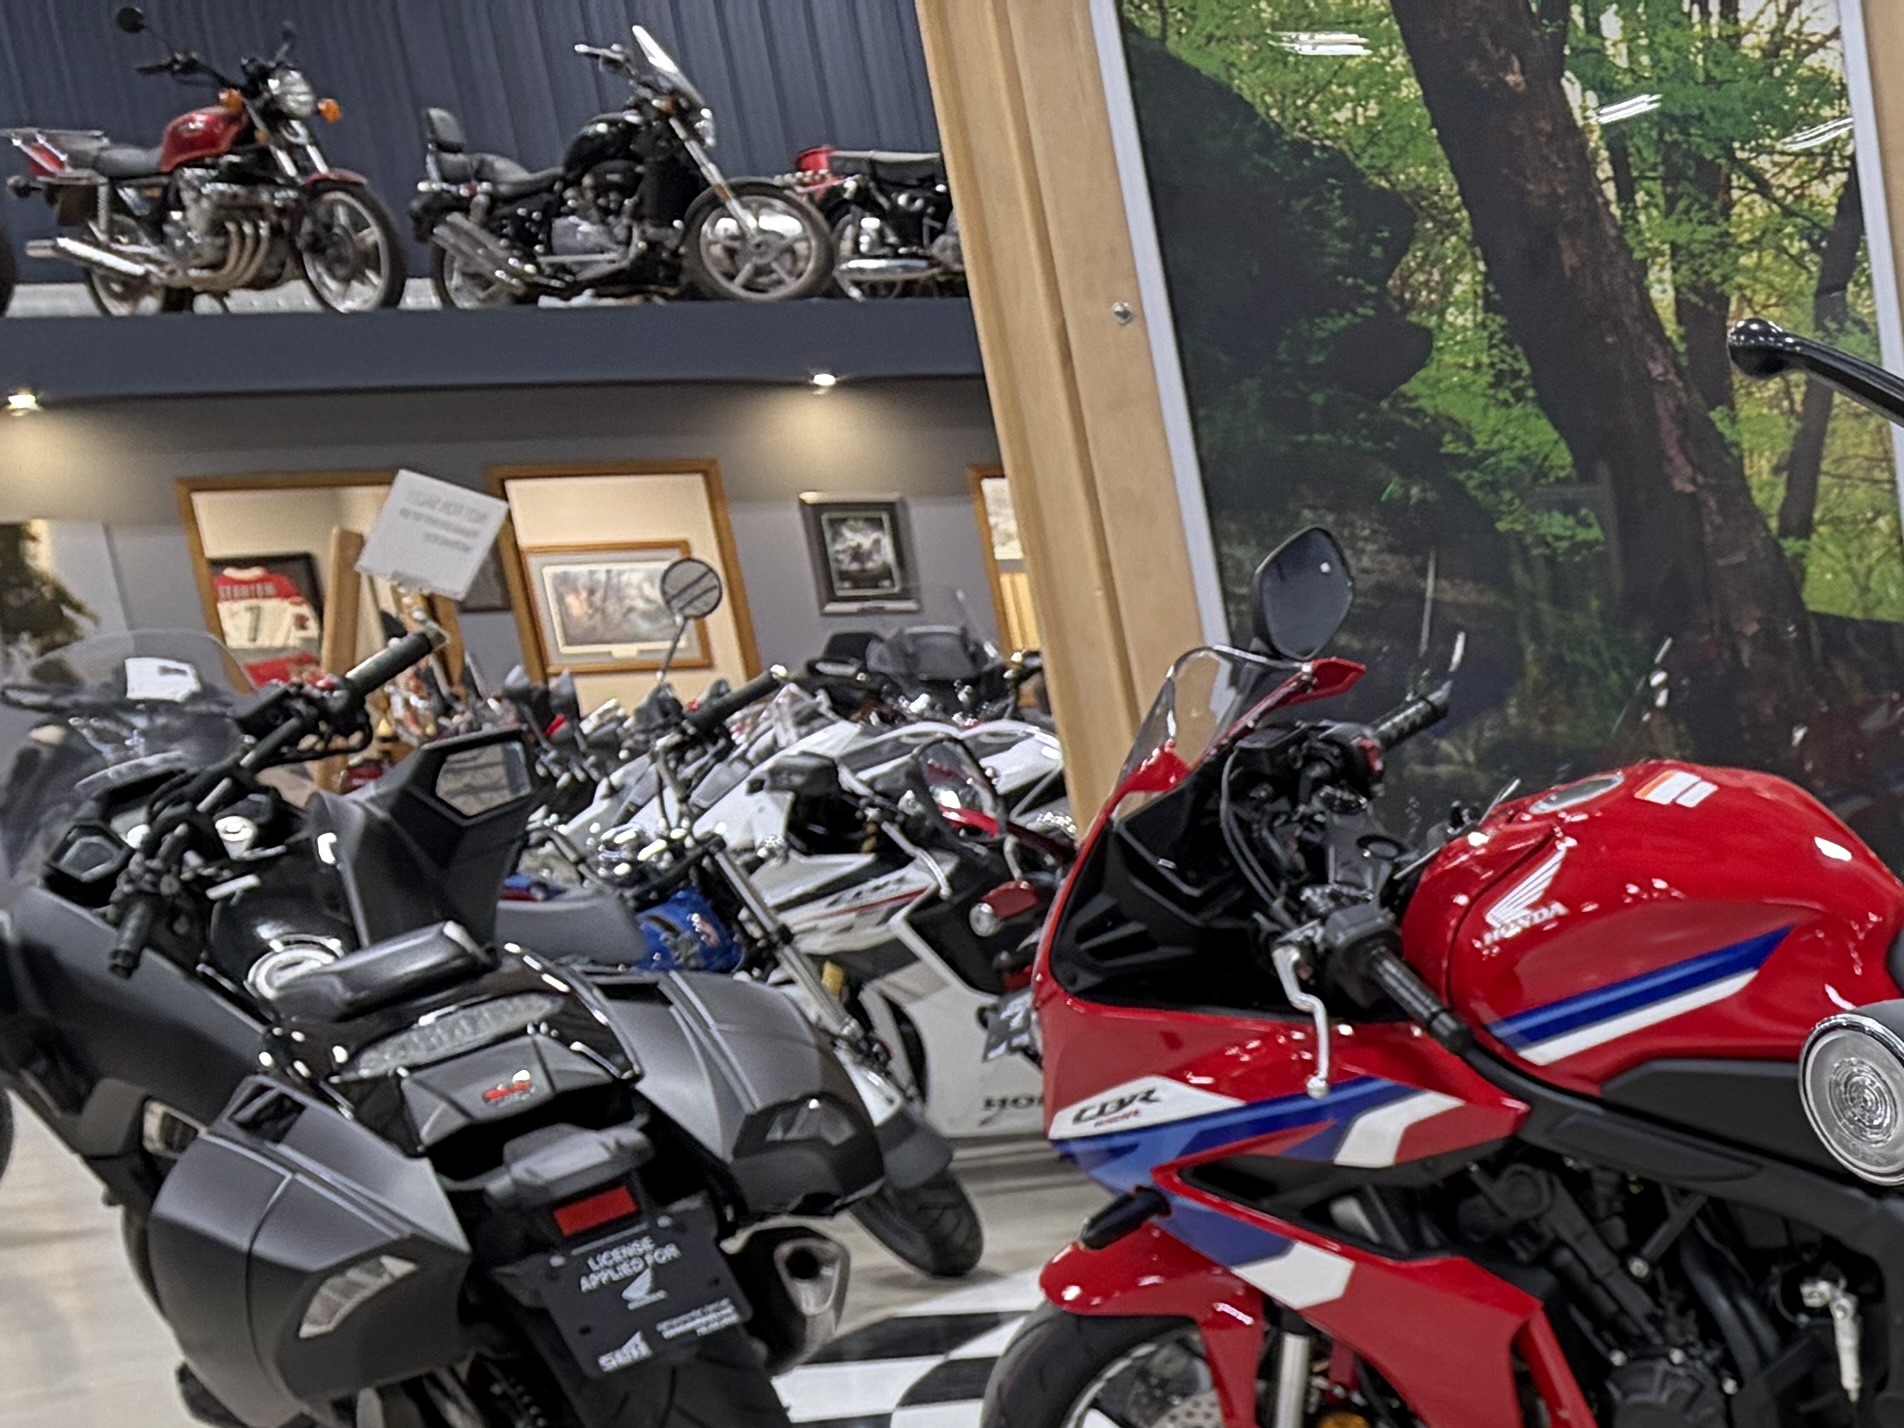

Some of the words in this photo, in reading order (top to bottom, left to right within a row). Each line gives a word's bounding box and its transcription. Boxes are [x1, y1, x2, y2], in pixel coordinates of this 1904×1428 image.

[1482, 900, 1570, 946] HONDA
[1072, 1086, 1162, 1126] CBR
[580, 1256, 645, 1293] APPLIED
[645, 1243, 682, 1265] FOR
[587, 1235, 655, 1272] LICENSE
